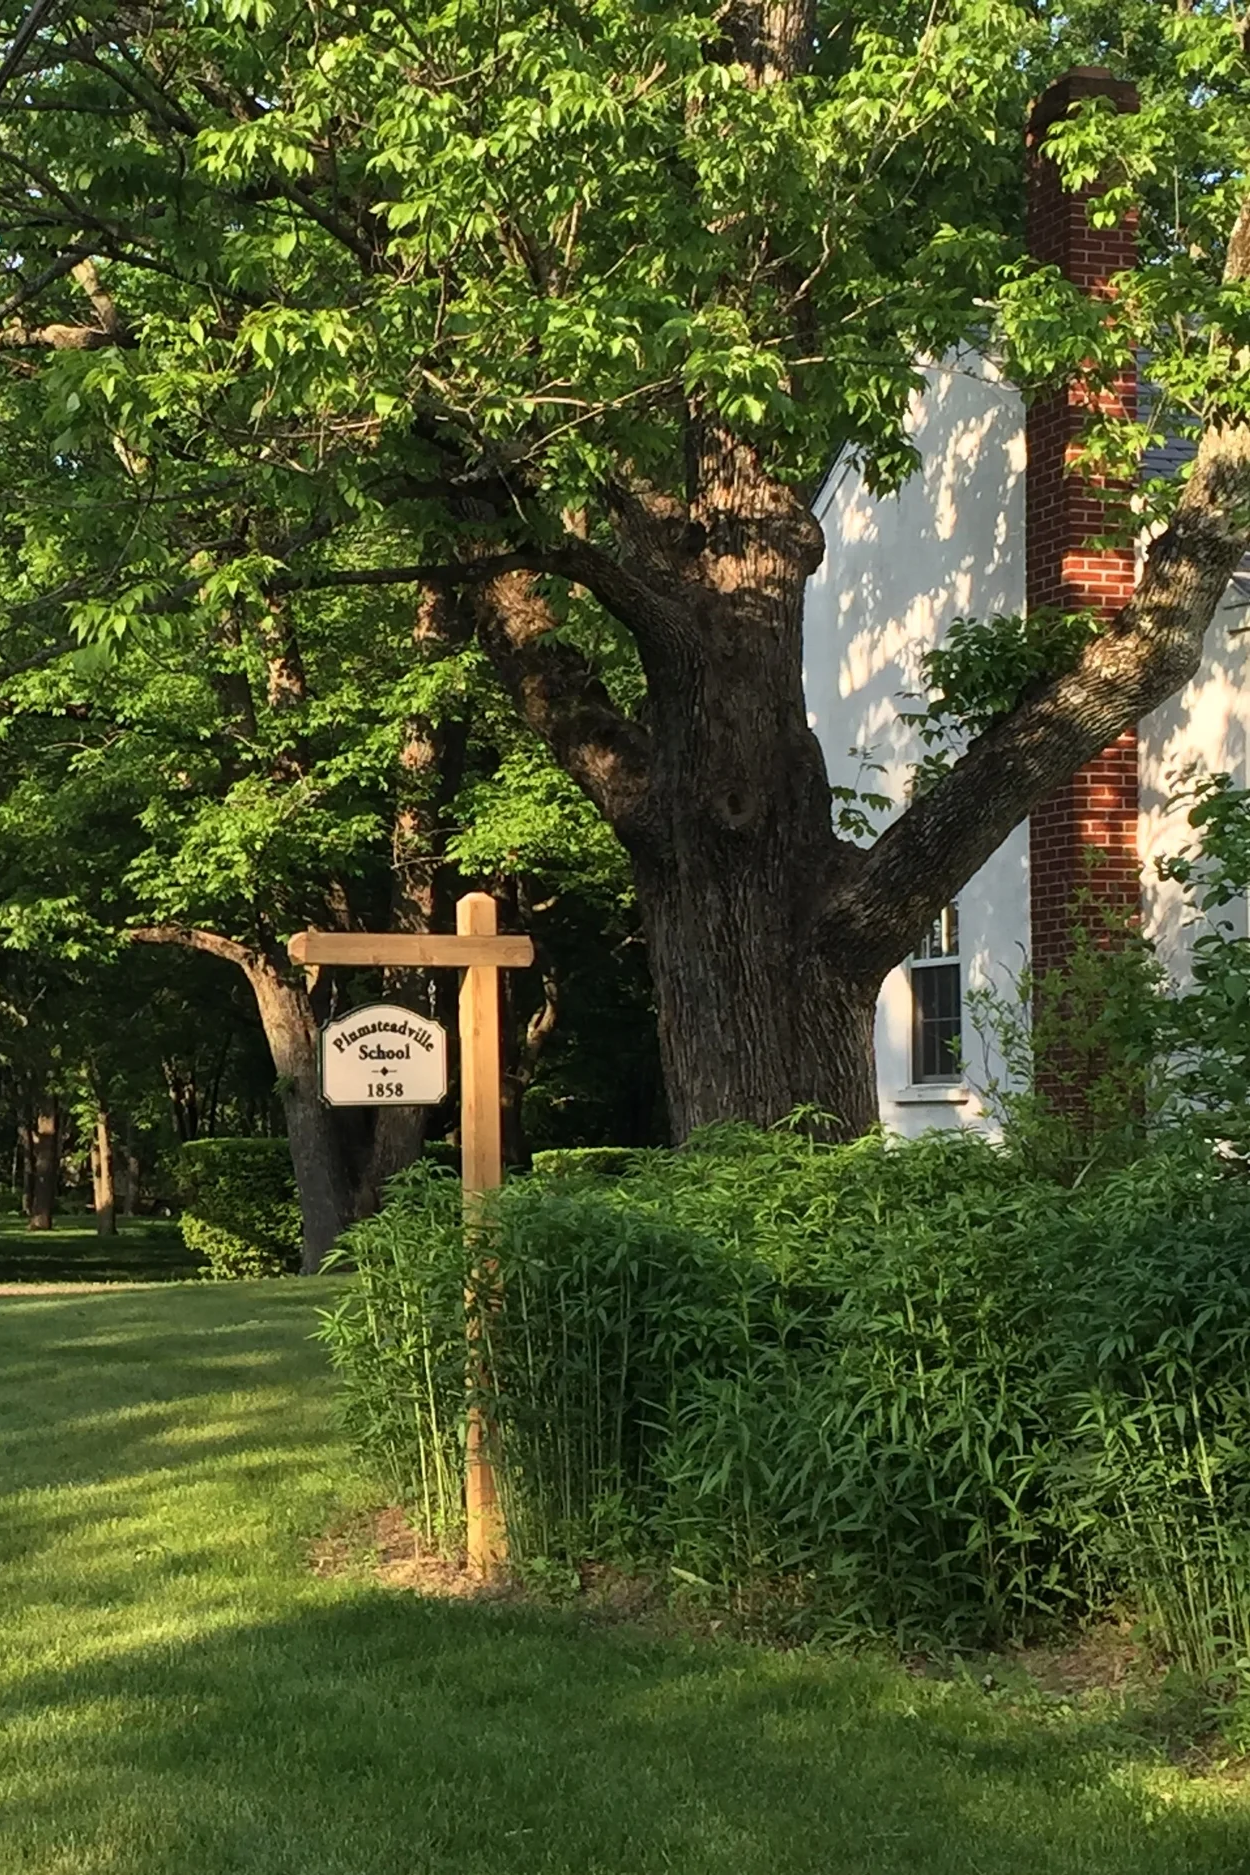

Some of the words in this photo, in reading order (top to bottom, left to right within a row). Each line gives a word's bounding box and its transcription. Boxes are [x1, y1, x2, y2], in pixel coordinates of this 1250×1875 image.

[332, 1020, 434, 1053] Plumsteadville
[358, 1043, 411, 1060] School
[367, 1082, 404, 1098] 1858
